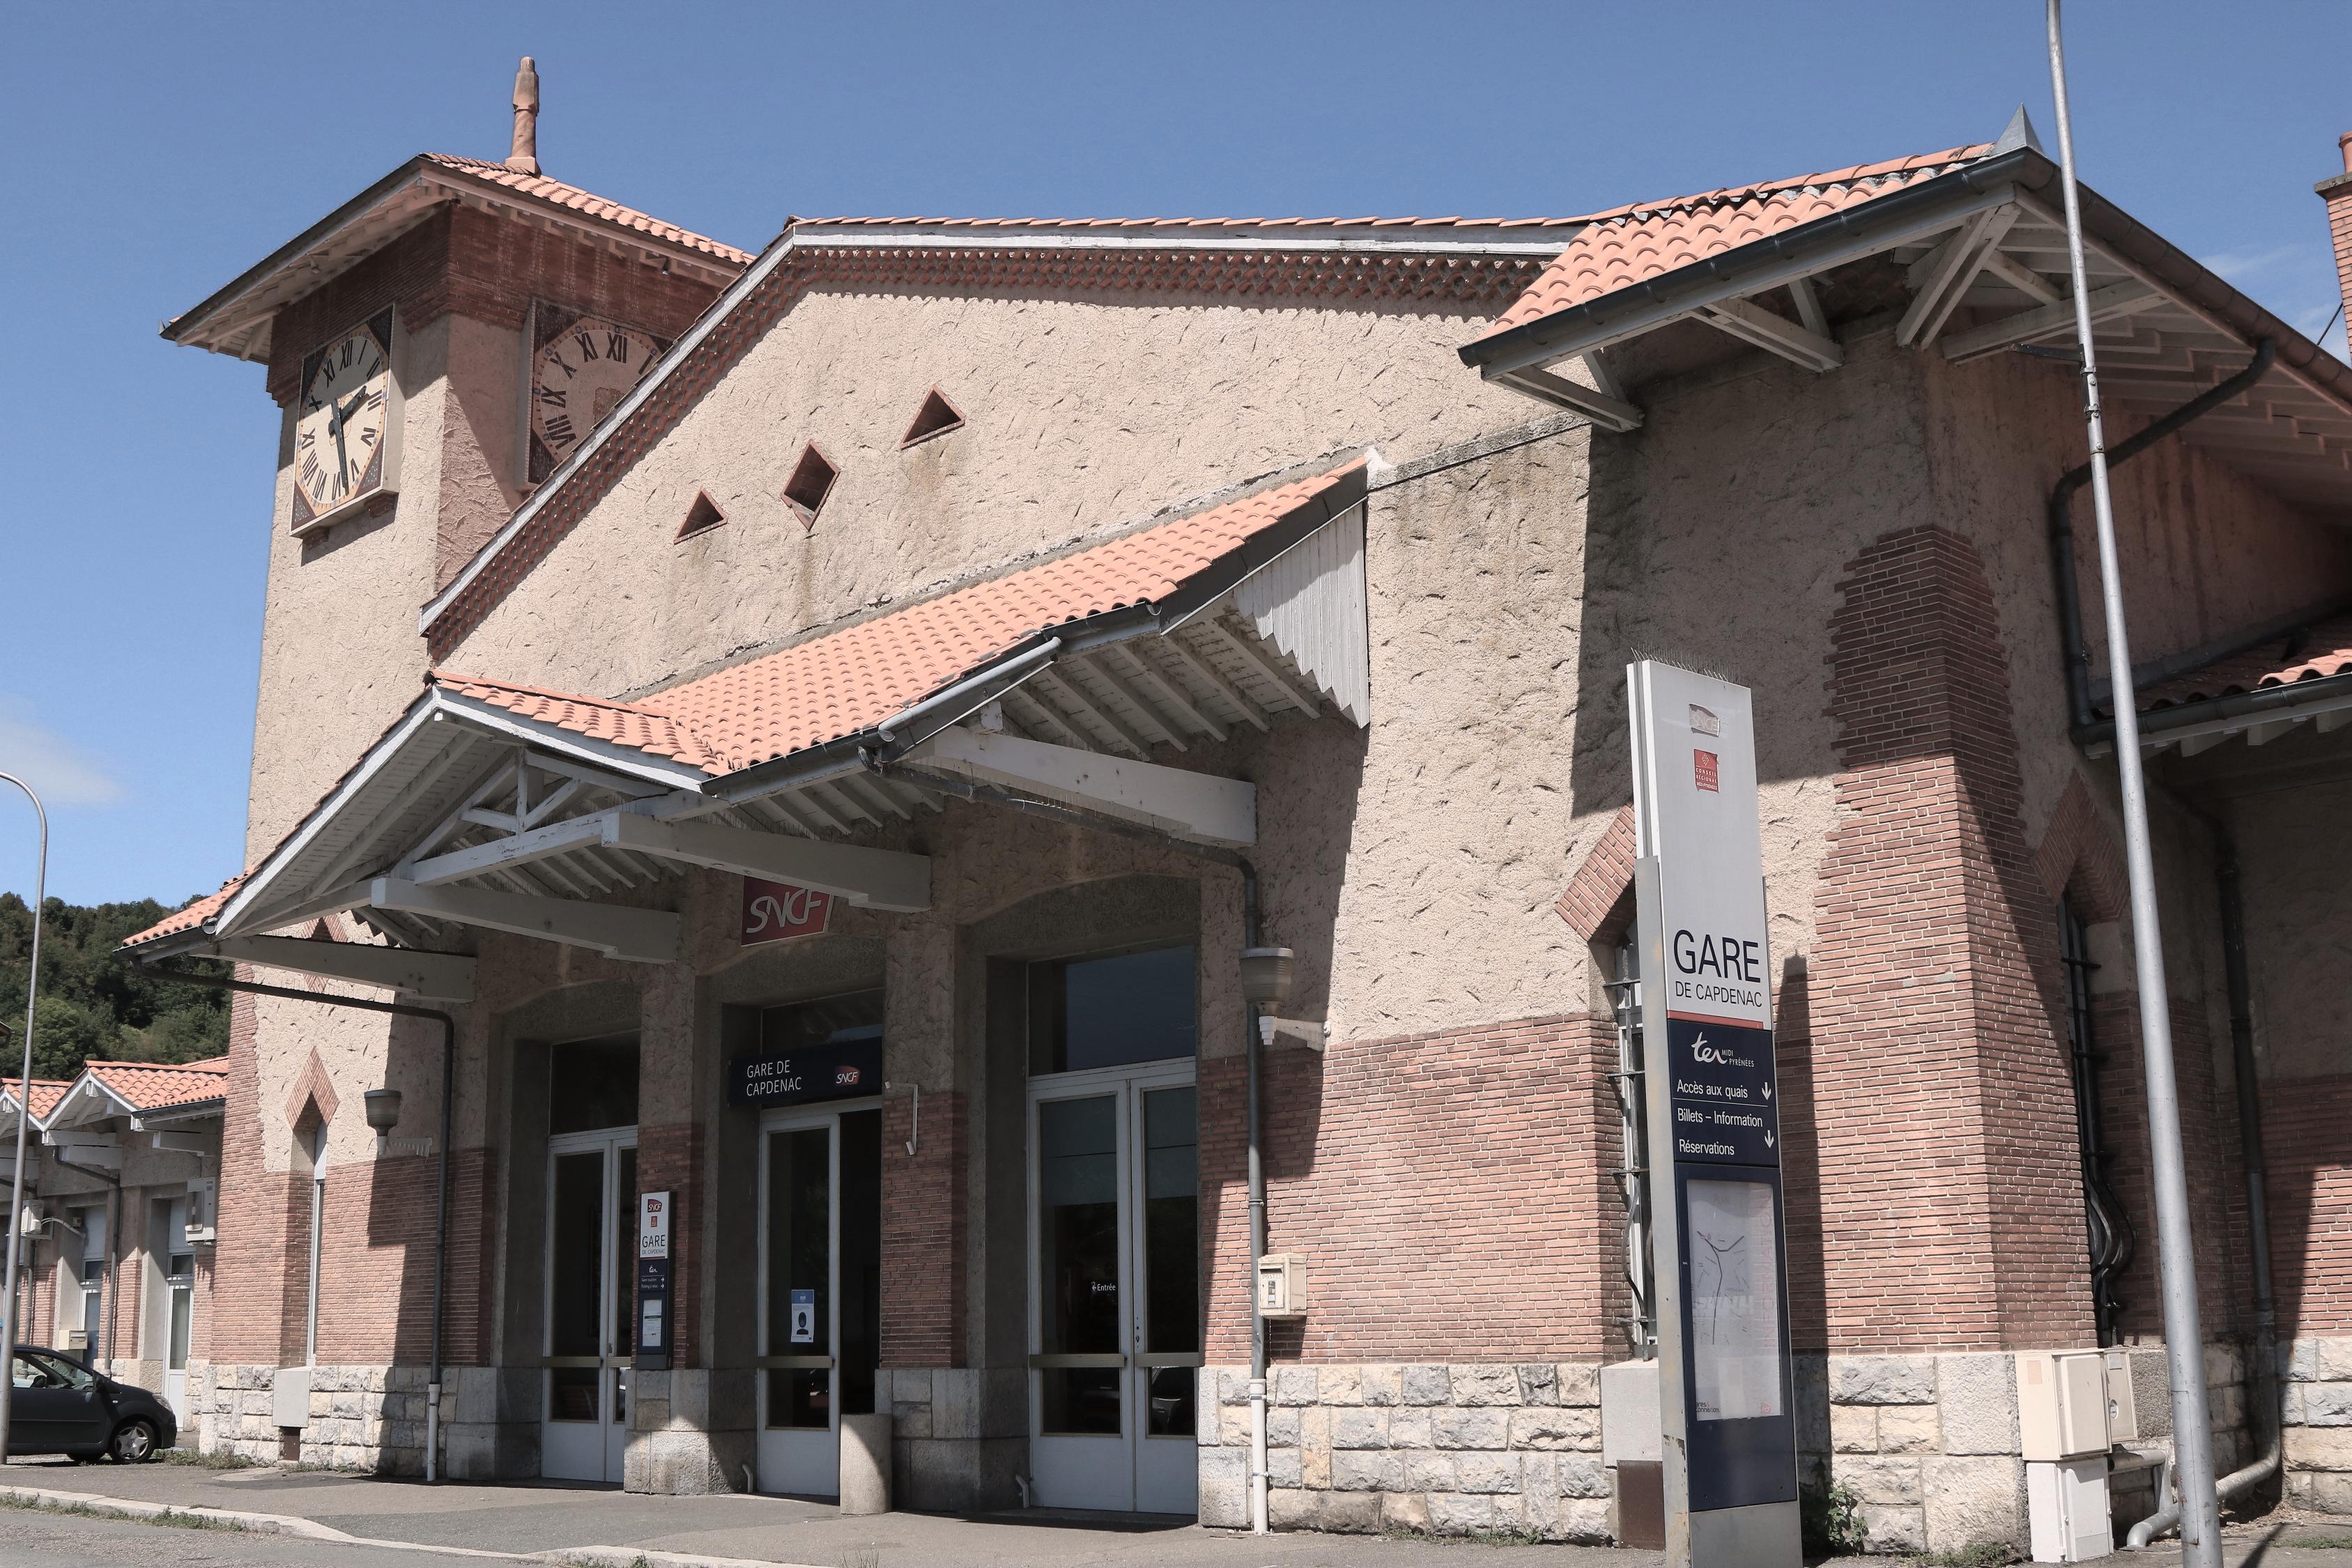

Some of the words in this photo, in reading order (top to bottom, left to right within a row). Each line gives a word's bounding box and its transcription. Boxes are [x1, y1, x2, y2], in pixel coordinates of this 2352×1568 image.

[339, 339, 353, 371] XII
[606, 331, 627, 364] XII
[323, 358, 336, 388] XI
[549, 351, 577, 380] X
[308, 395, 322, 413] X
[1696, 767, 1717, 777] CONSEIL
[746, 889, 823, 934] SNCF
[1674, 929, 1761, 983] GARE
[1675, 981, 1692, 998] DE
[1696, 983, 1762, 1008] CAPDENAC
[1691, 1031, 1728, 1064] ter
[747, 1062, 774, 1078] GARE
[776, 1059, 790, 1074] DE
[1729, 1056, 1755, 1068] PYRÉNÉES
[746, 1077, 801, 1097] CAPDENAC
[836, 1071, 858, 1084] SNCF
[1677, 1079, 1703, 1095] Accès
[1706, 1086, 1722, 1096] aux
[1725, 1084, 1748, 1100] quais
[1677, 1107, 1703, 1123] Billets
[1714, 1110, 1763, 1128] Information
[1679, 1139, 1735, 1156] Réservations
[648, 1203, 662, 1211] SNCF
[642, 1235, 666, 1248] GARE
[1097, 1283, 1116, 1291] Entrée
